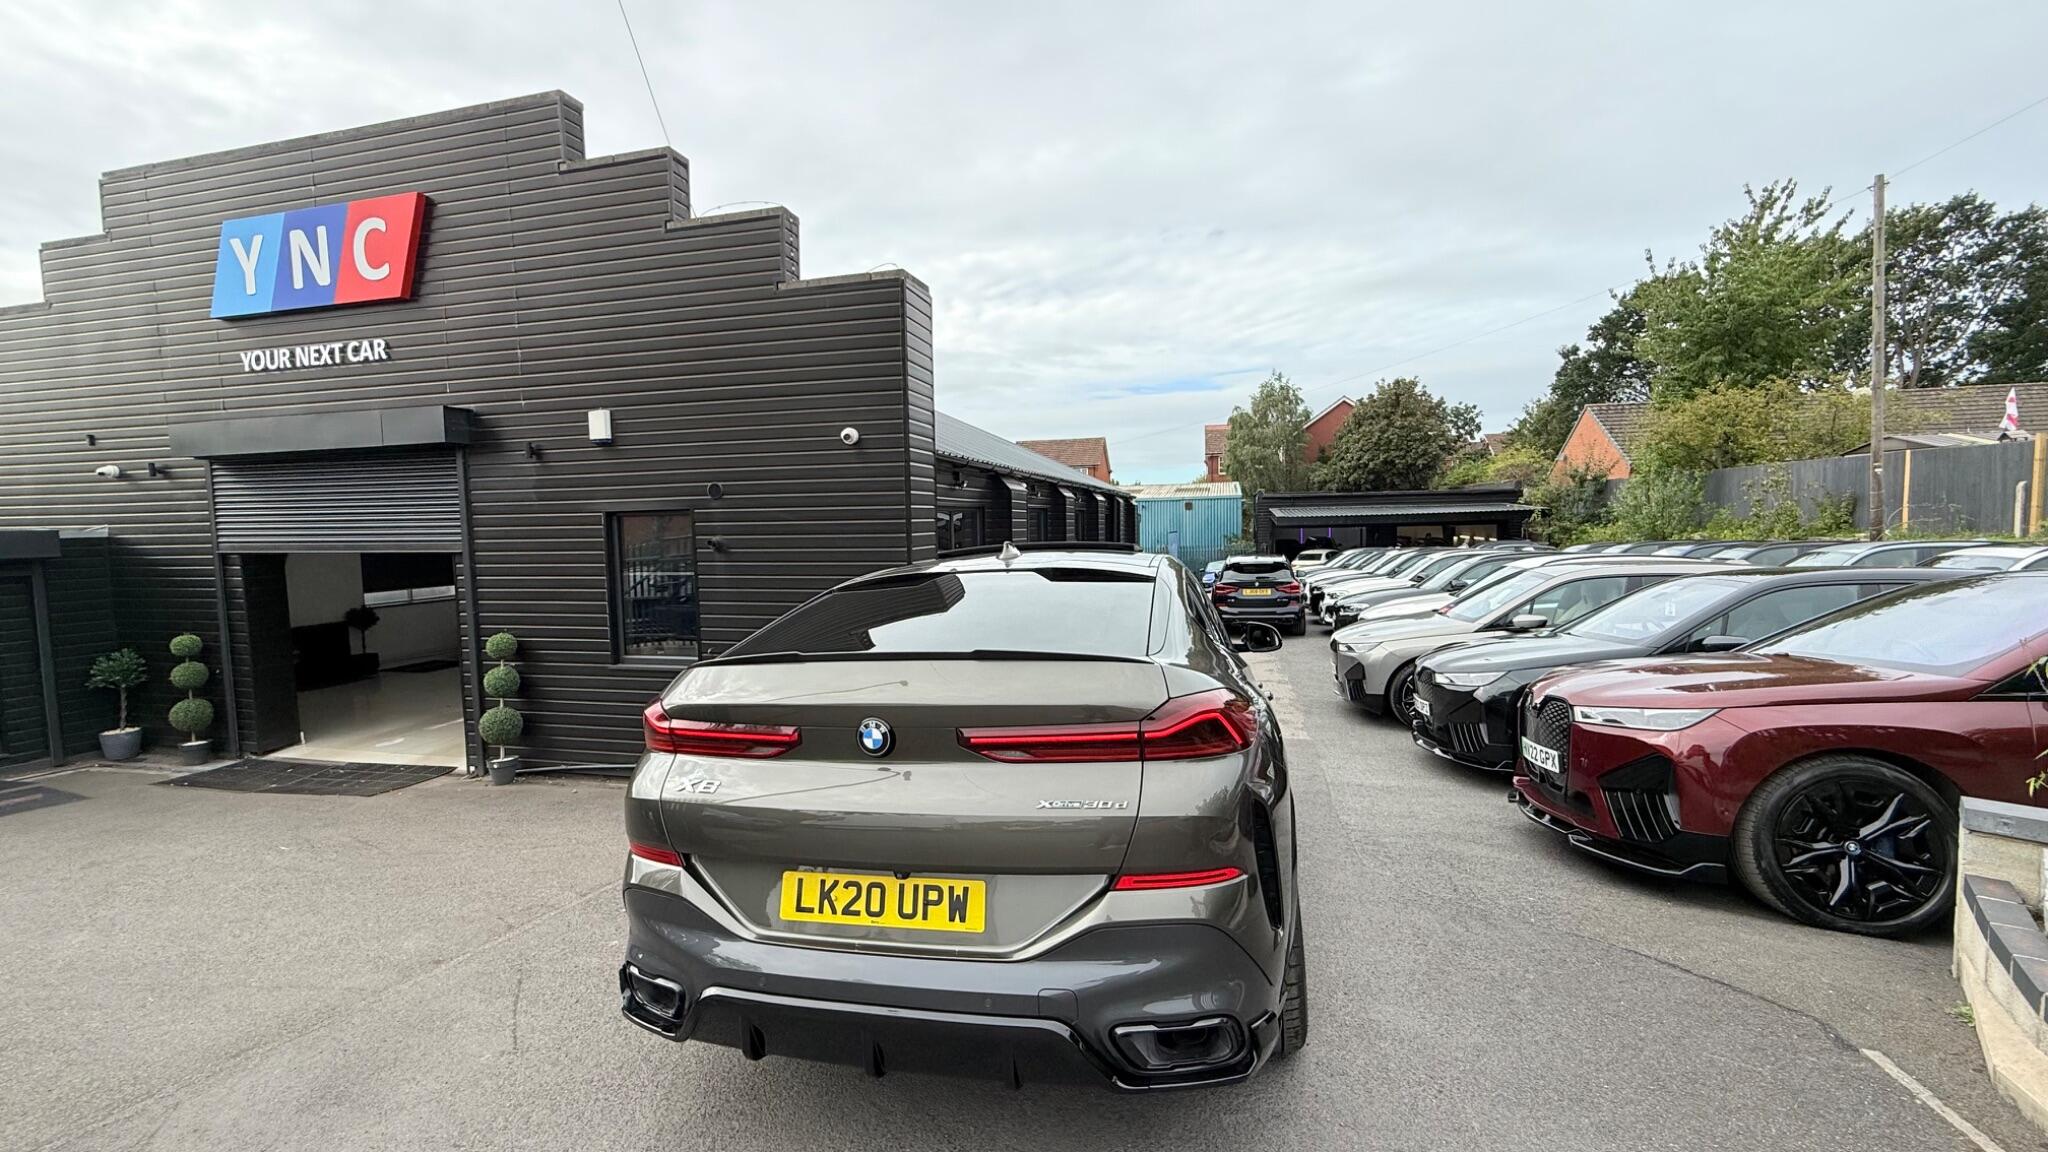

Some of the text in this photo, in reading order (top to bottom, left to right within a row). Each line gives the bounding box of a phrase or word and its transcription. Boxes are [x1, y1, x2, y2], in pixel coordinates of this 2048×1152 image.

[229, 217, 390, 296] YNC
[240, 338, 388, 372] YOUR NEXT CAR
[1539, 749, 1557, 770] GPX
[795, 877, 969, 923] LK20 UPW
